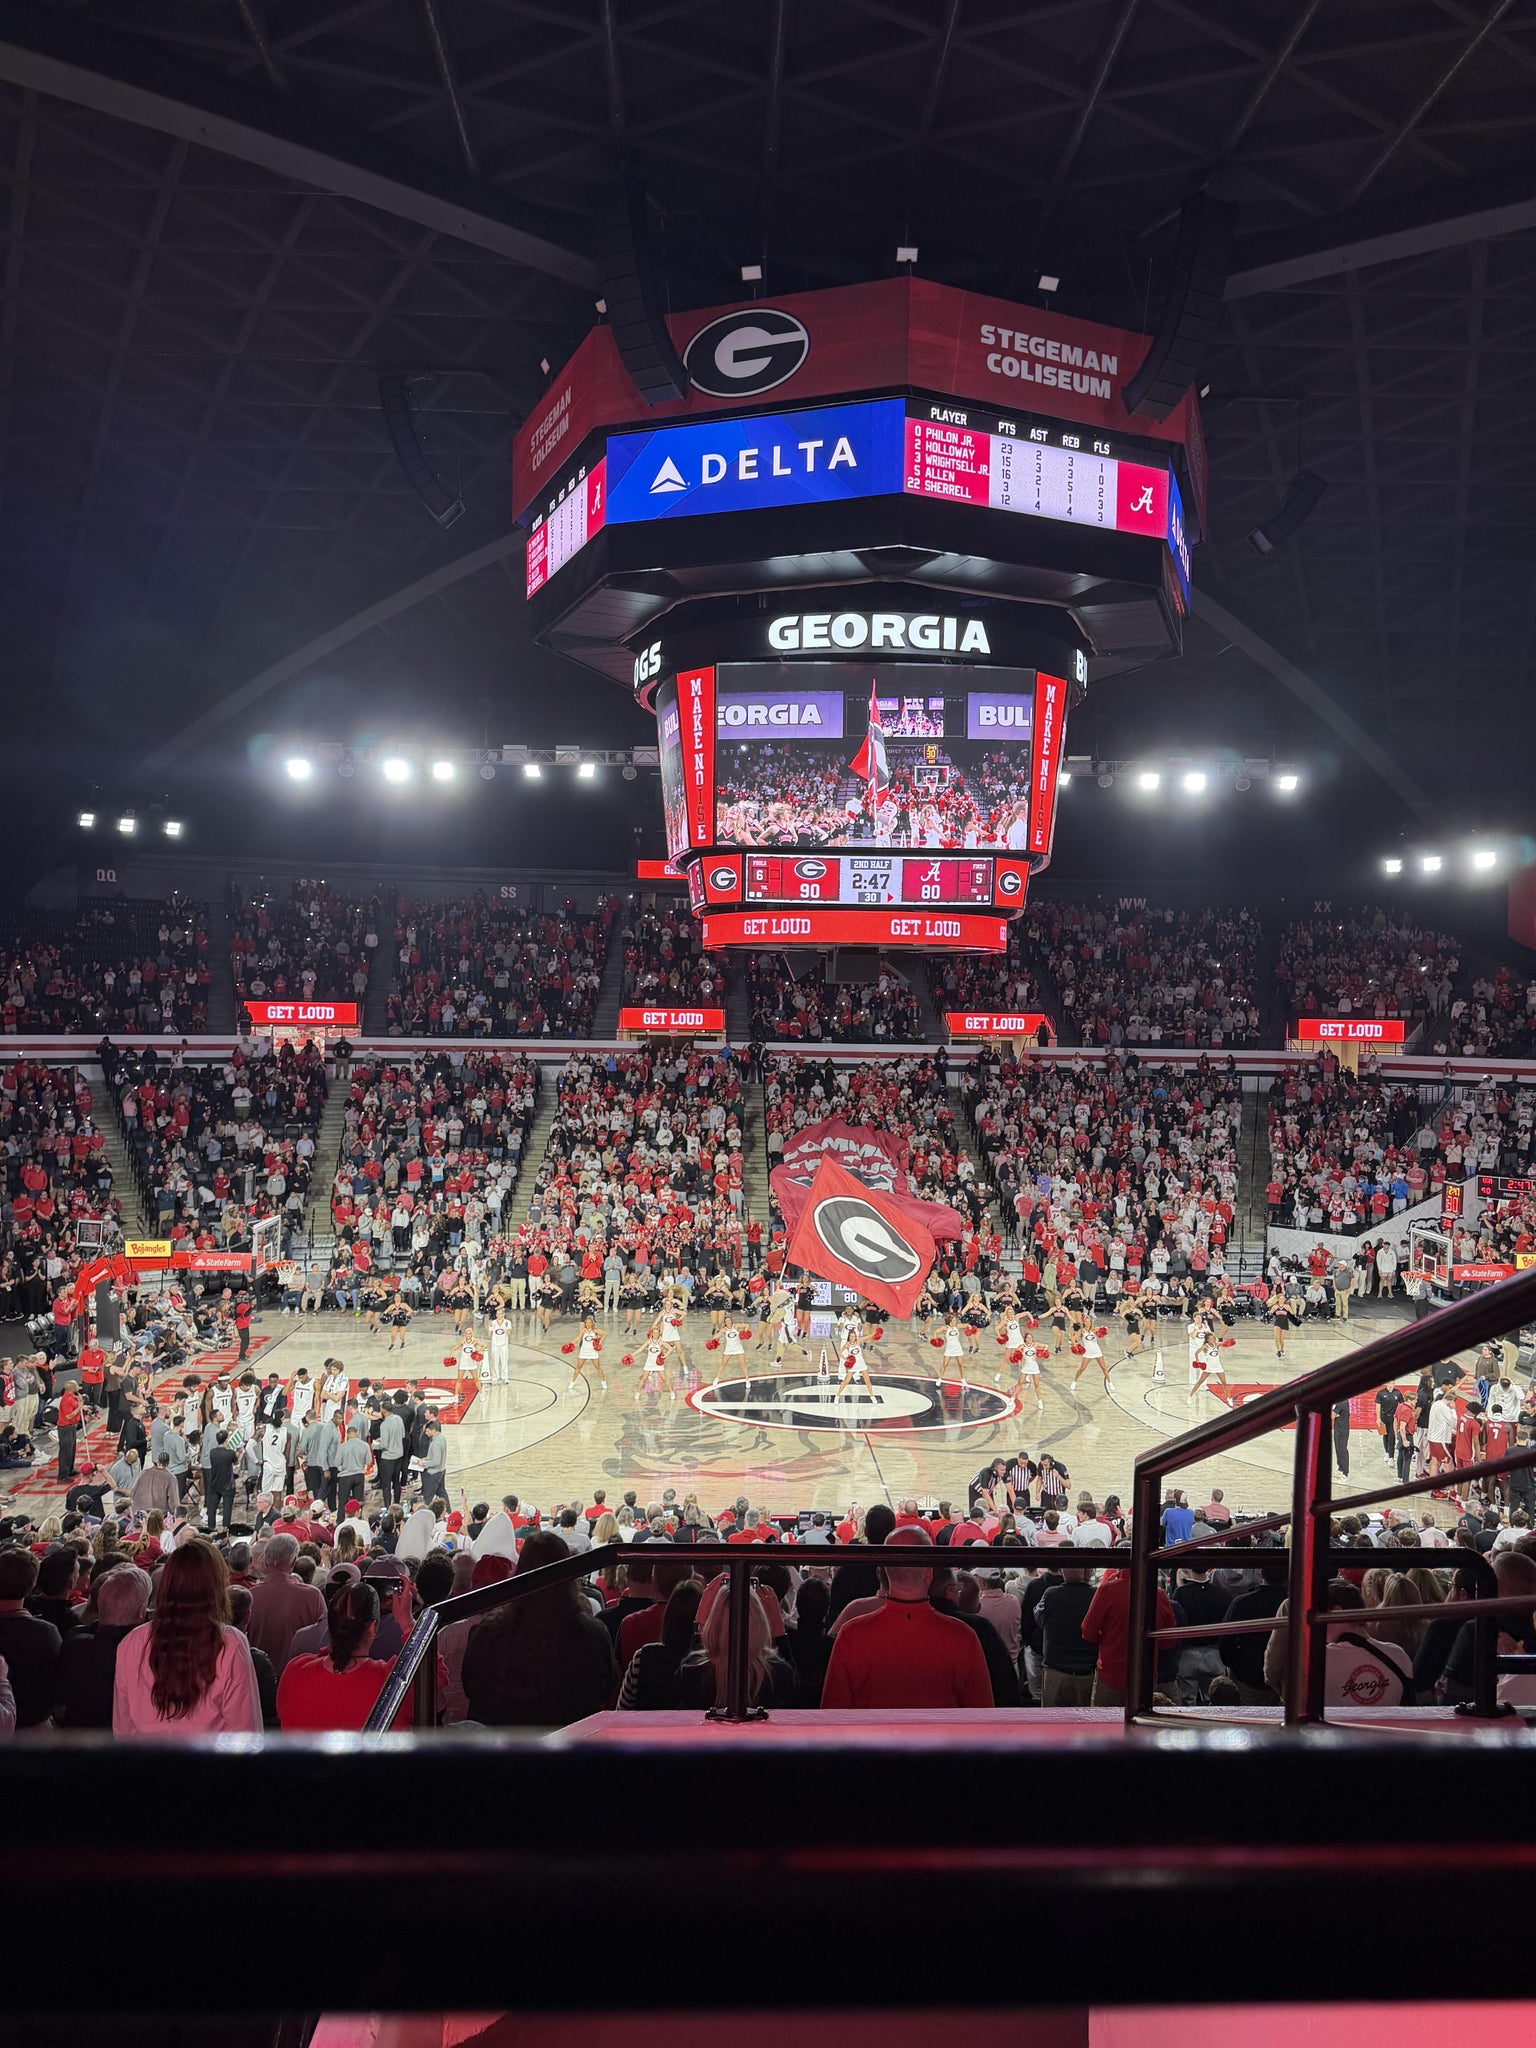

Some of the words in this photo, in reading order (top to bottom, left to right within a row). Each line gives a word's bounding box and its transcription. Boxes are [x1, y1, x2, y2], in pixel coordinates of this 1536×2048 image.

[980, 324, 1118, 375] STEGEMAN
[986, 352, 1111, 399] COLISEUM
[530, 385, 572, 453] STEGEMAN
[930, 407, 967, 426] PLAYER
[998, 421, 1016, 435] PTS
[1030, 428, 1048, 442] AST
[1062, 435, 1080, 448] REB
[1094, 441, 1110, 455] FLS
[532, 412, 569, 472] COLISEUM
[914, 425, 921, 437] 0
[925, 427, 958, 444] PHILON
[961, 435, 975, 447] JR.
[1001, 443, 1013, 454] 23
[1036, 450, 1042, 461] 2
[1068, 456, 1074, 467] 3
[1100, 463, 1103, 473] 1
[701, 436, 858, 485] DELTA
[914, 438, 921, 450] 2
[925, 440, 975, 460] HOLLOWAY
[1001, 456, 1011, 467] 15
[1036, 462, 1041, 473] 3
[1068, 469, 1073, 479] 3
[1099, 475, 1104, 485] 0
[914, 451, 921, 463] 3
[925, 453, 976, 473] WRIGHTSELL
[977, 464, 990, 476] JR.
[1001, 469, 1011, 480] 16
[1036, 475, 1041, 485] 2
[1067, 481, 1073, 492] 5
[1098, 487, 1104, 498] 2
[914, 464, 920, 476] 5
[925, 467, 955, 482] ALLEN
[1003, 481, 1009, 492] 3
[1037, 488, 1040, 498] 1
[1069, 494, 1072, 504] 1
[1098, 500, 1103, 510] 3
[907, 476, 920, 489] 22
[924, 480, 971, 499] SHERRELL
[1001, 494, 1010, 505] 12
[1035, 501, 1040, 510] 4
[1067, 506, 1072, 516] 4
[1098, 512, 1103, 522] 3
[768, 613, 991, 654] GEORGIA
[690, 678, 703, 750] MAKE
[1043, 684, 1056, 756] MAKE
[853, 861, 868, 869] 2ND
[870, 861, 890, 869] HALF
[755, 869, 764, 881] 6
[852, 873, 890, 889] 2:47
[975, 873, 983, 884] 5
[500, 886, 517, 899] SS
[800, 883, 820, 898] 90
[864, 893, 877, 902] 30
[921, 884, 941, 899] 80
[1119, 898, 1147, 910] WW
[1313, 901, 1331, 913] XX
[743, 919, 769, 935] GET
[771, 918, 811, 935] LOUD
[891, 919, 921, 936] GET
[925, 920, 961, 937] LOUD
[267, 1006, 295, 1020] GET
[298, 1006, 335, 1020] LOUD
[643, 1012, 667, 1026] GET
[670, 1013, 703, 1026] LOUD
[965, 1016, 989, 1030] GET
[992, 1017, 1025, 1030] LOUD
[1319, 1023, 1345, 1037] GET
[1348, 1024, 1383, 1038] LOUD
[1508, 1180, 1531, 1190] 2:47
[130, 1243, 166, 1255] Bojangles
[844, 1292, 858, 1303] 80
[271, 1434, 279, 1446] 2
[1341, 1678, 1391, 1697] Georgia
